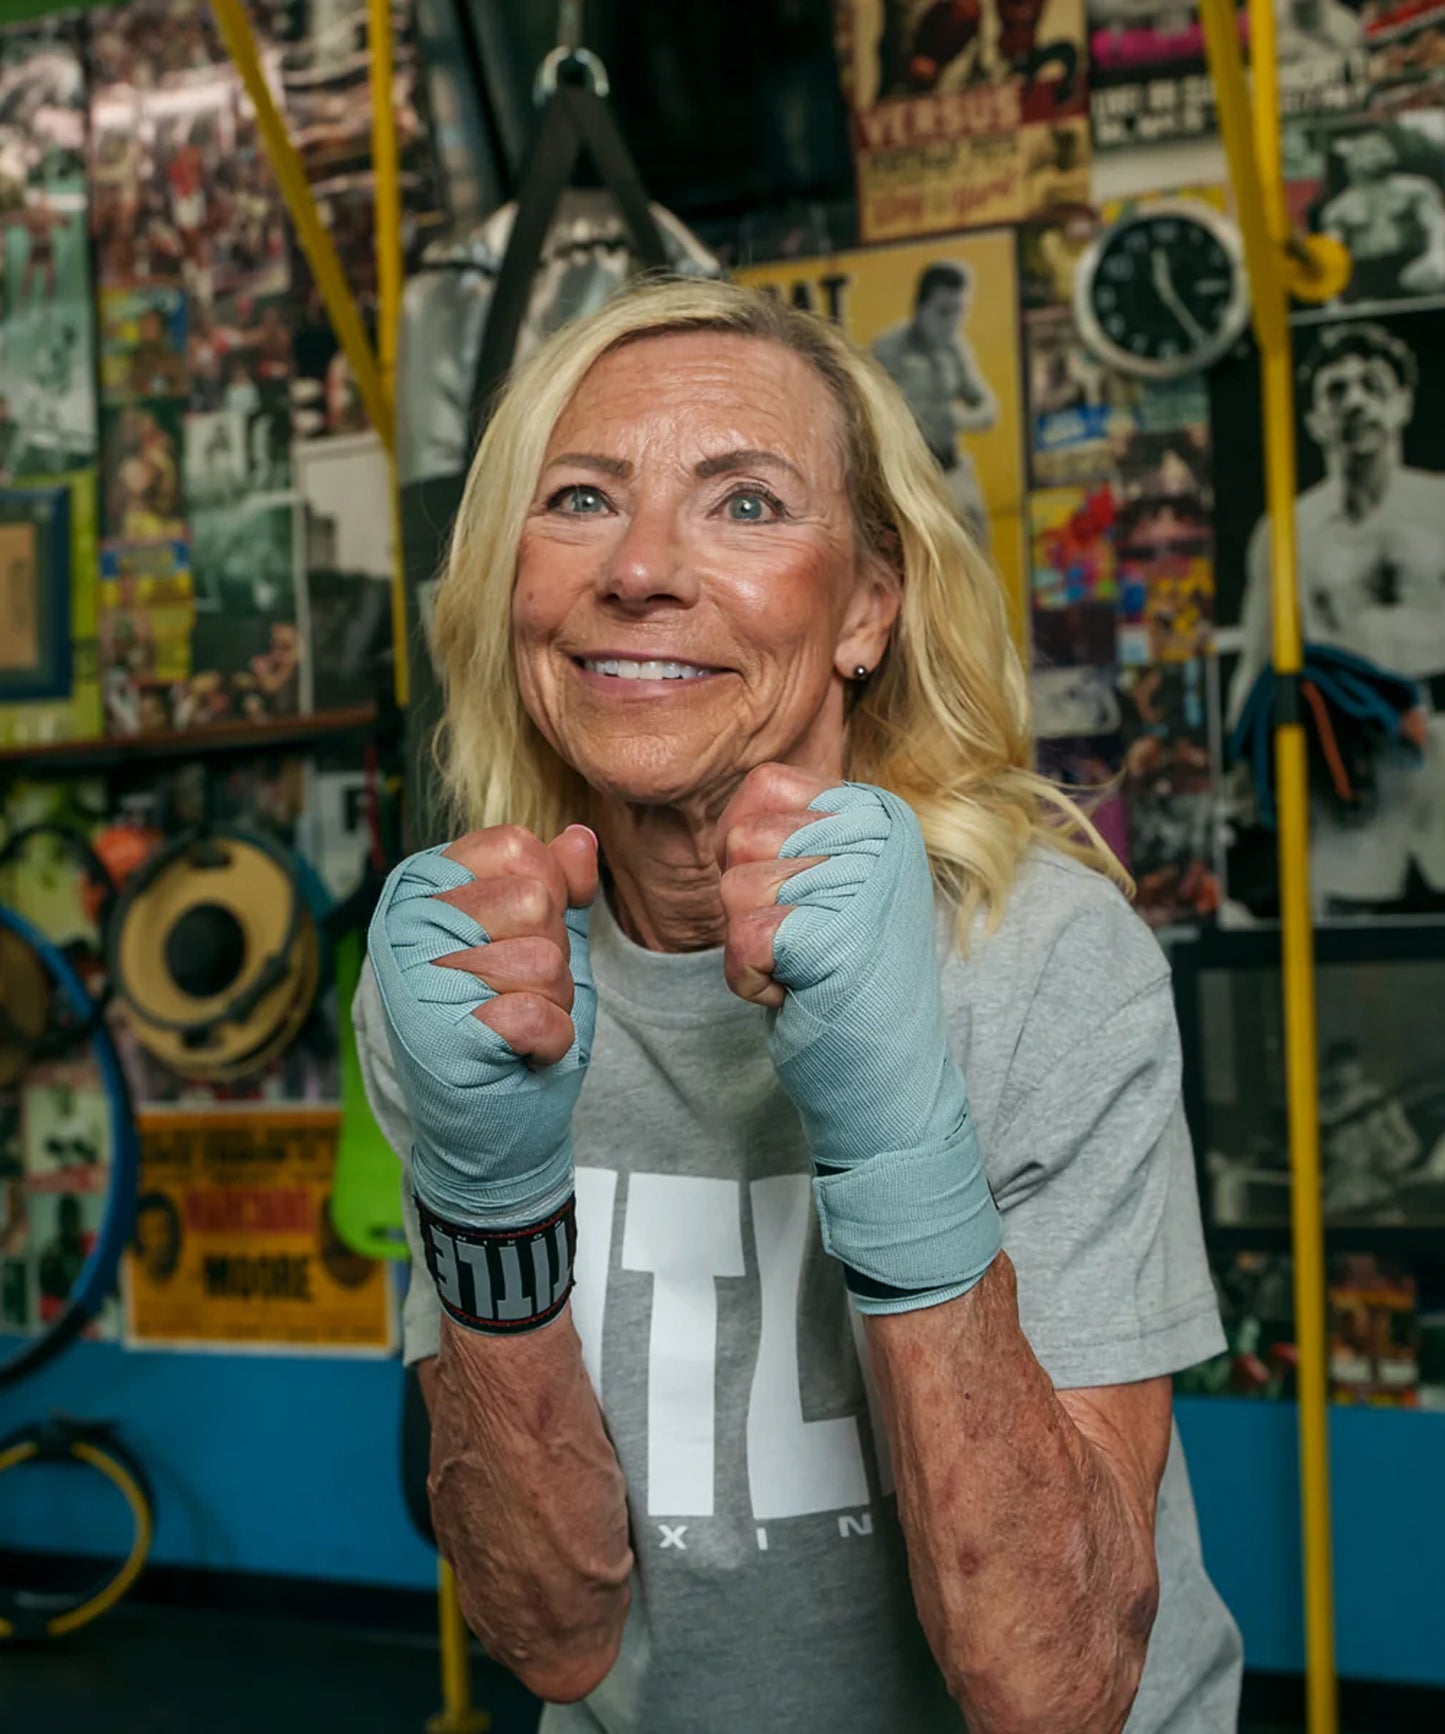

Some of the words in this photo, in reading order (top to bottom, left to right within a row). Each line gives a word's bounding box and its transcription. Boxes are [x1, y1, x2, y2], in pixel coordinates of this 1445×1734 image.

[861, 85, 1021, 148] VERSUS
[759, 275, 847, 326] AT
[429, 1221, 572, 1320] TITLE
